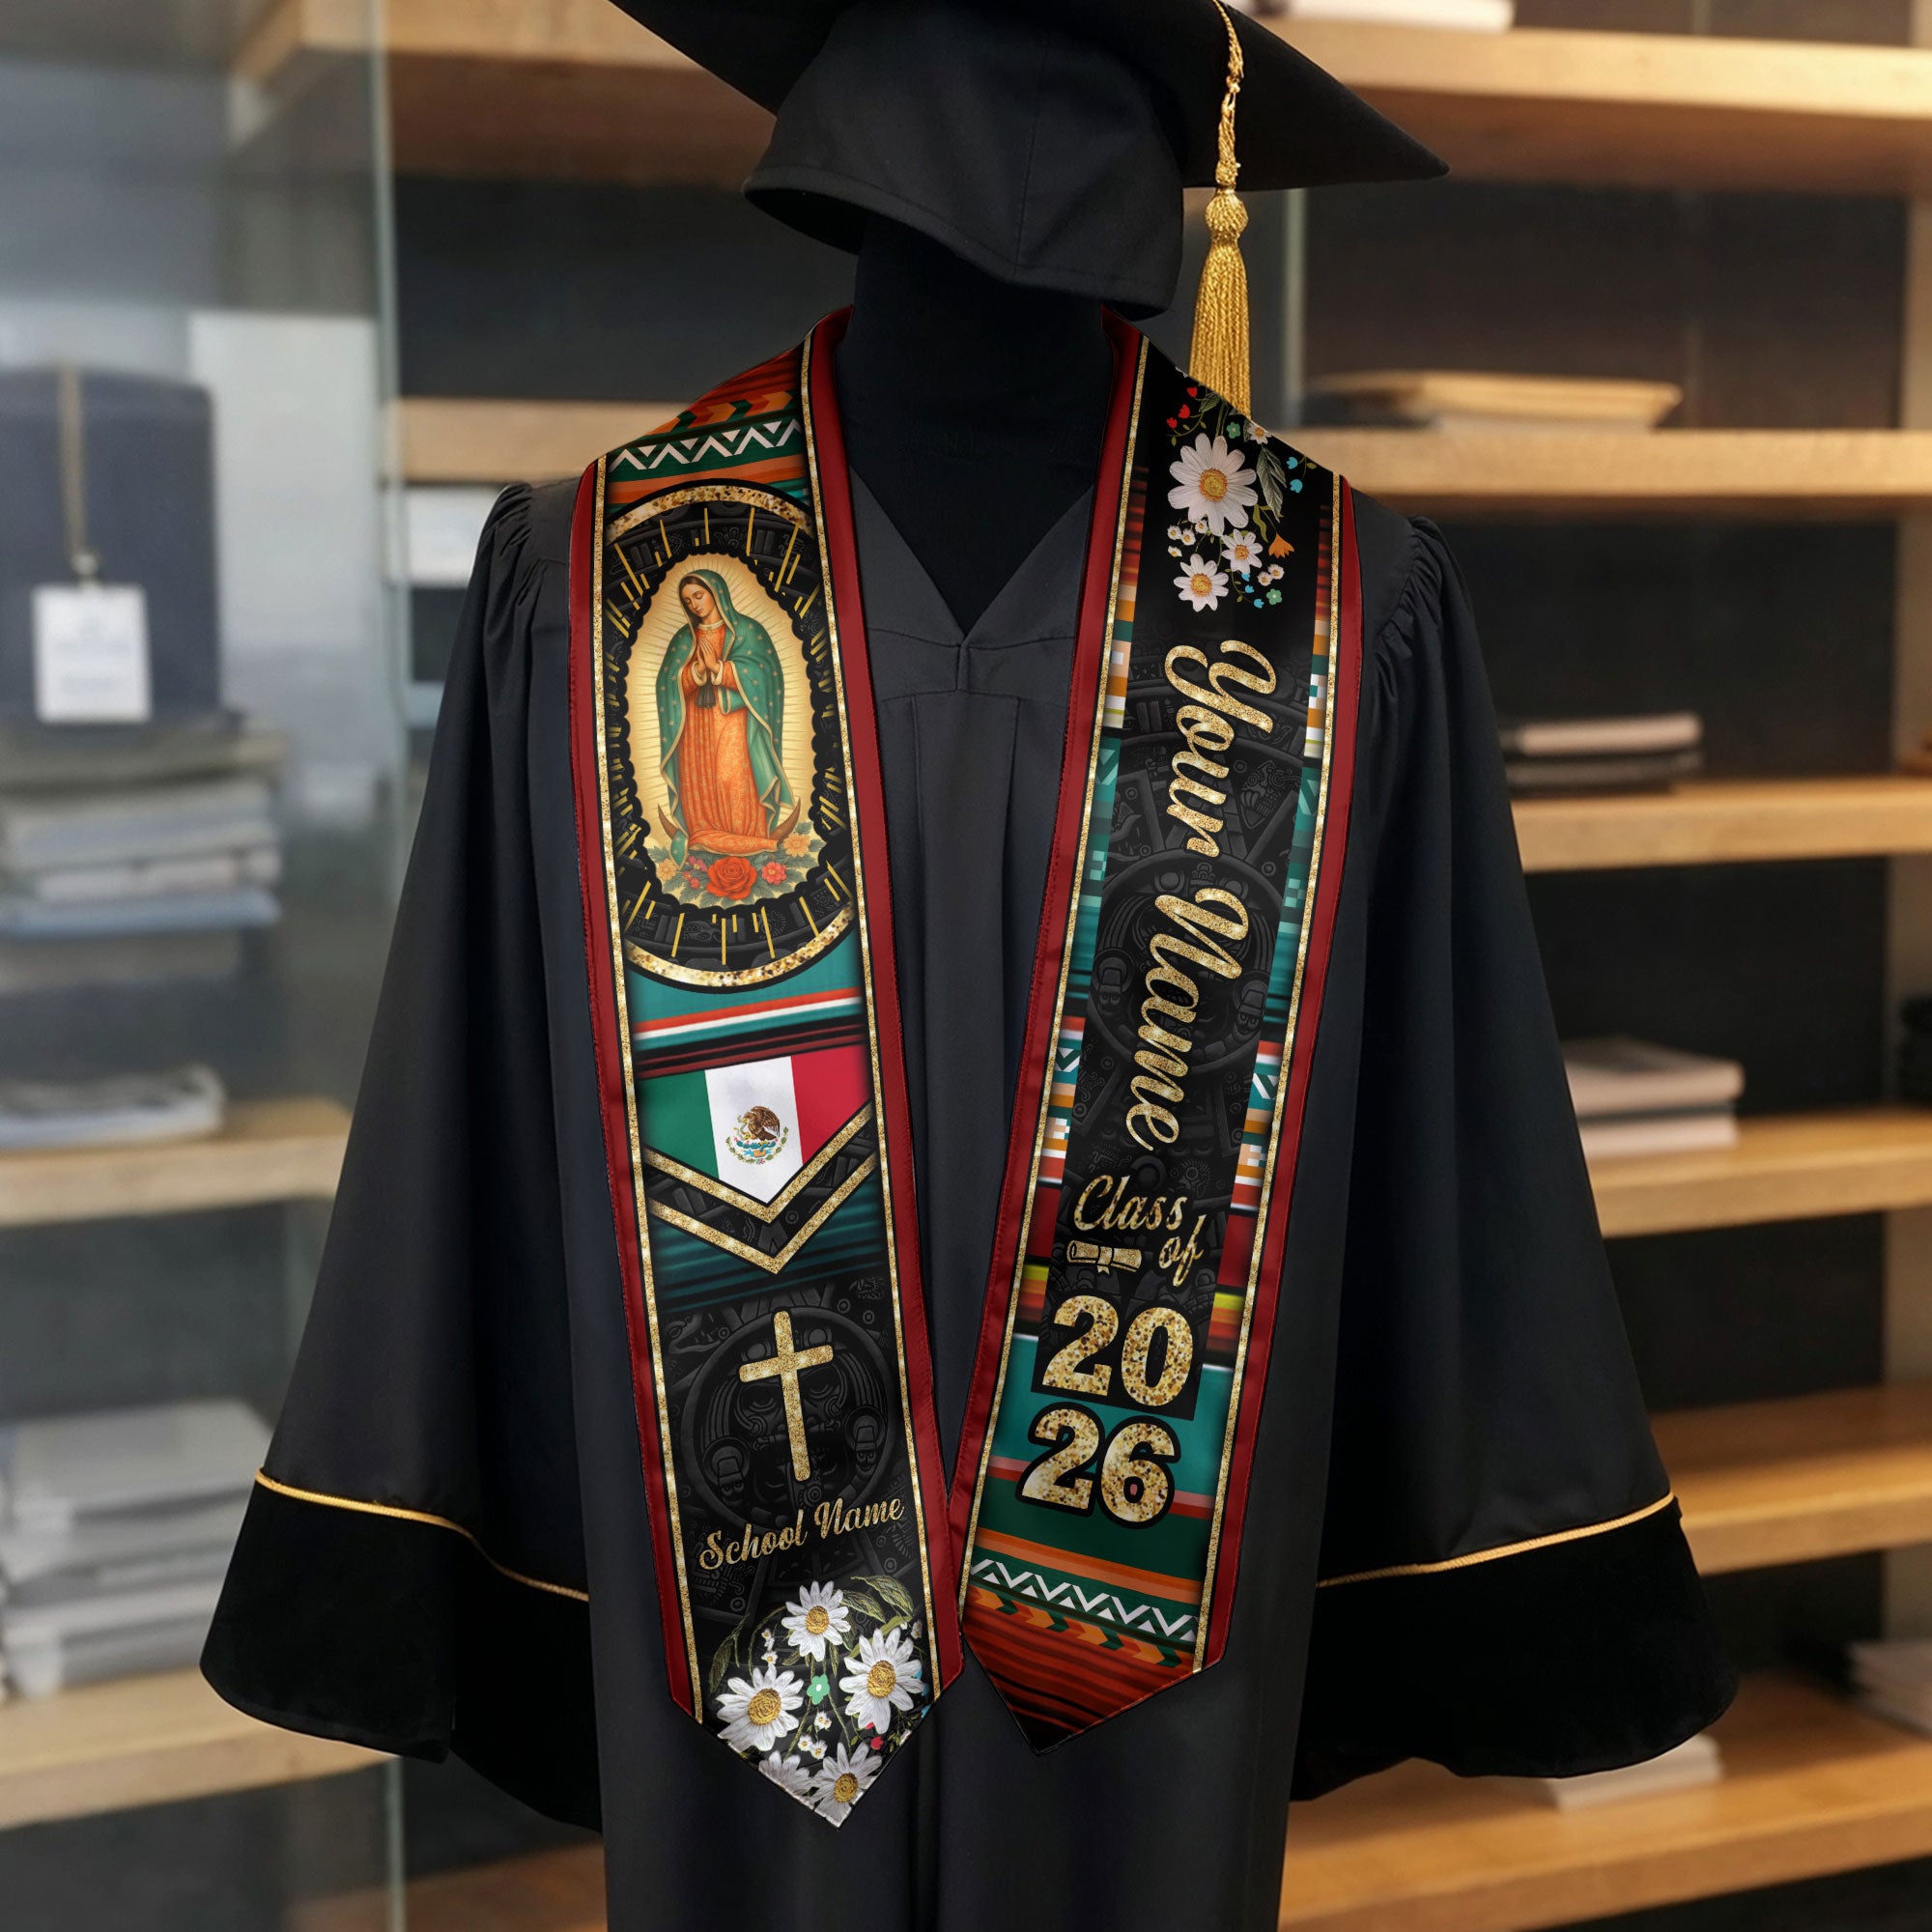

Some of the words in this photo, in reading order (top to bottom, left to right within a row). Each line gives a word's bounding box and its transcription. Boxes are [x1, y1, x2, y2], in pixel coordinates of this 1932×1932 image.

[1164, 639, 1277, 858] Your
[1125, 888, 1249, 1151] Name
[1073, 1174, 1188, 1232] Class
[1158, 1214, 1207, 1288] of
[1041, 1294, 1194, 1406] 20
[1021, 1408, 1177, 1522] 26
[698, 1509, 808, 1570] School
[813, 1497, 905, 1539] Name
